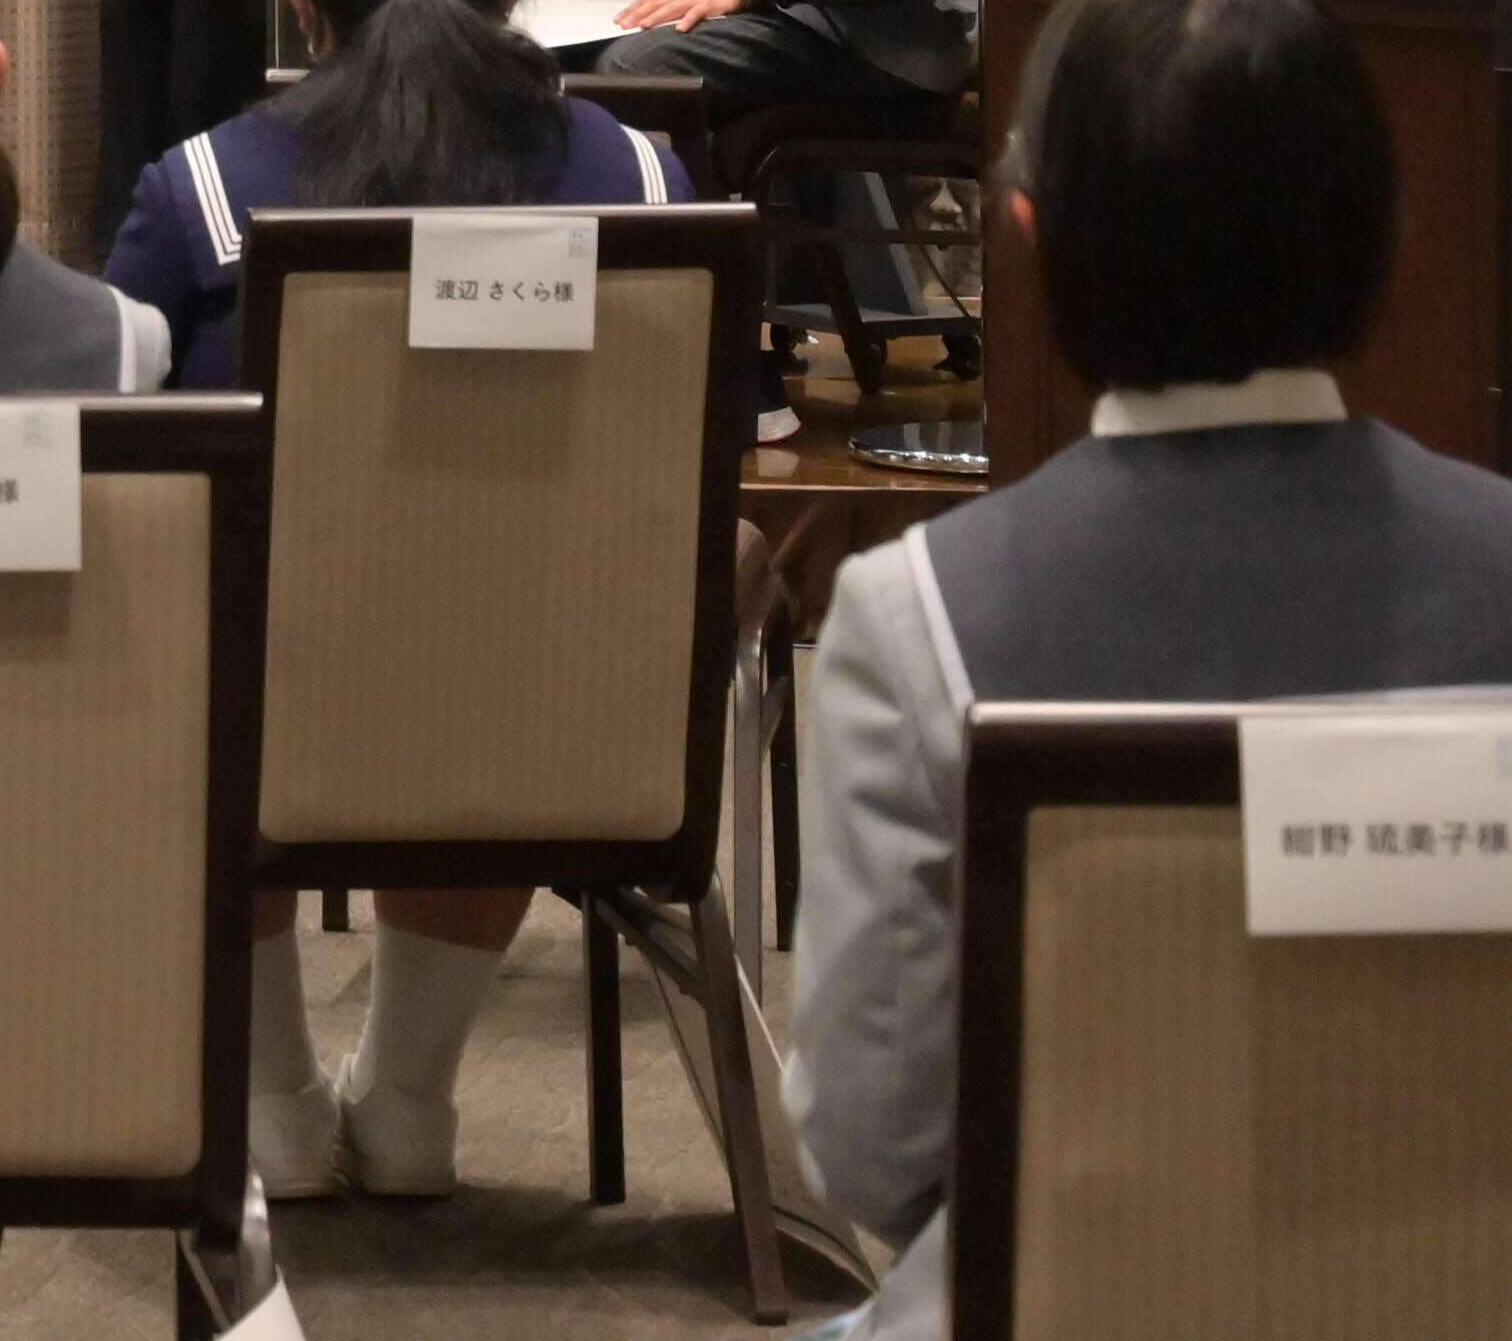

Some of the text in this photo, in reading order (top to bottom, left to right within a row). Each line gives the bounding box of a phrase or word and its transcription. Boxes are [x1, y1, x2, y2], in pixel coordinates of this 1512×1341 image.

[435, 278, 575, 303] 渡辺 さくら様
